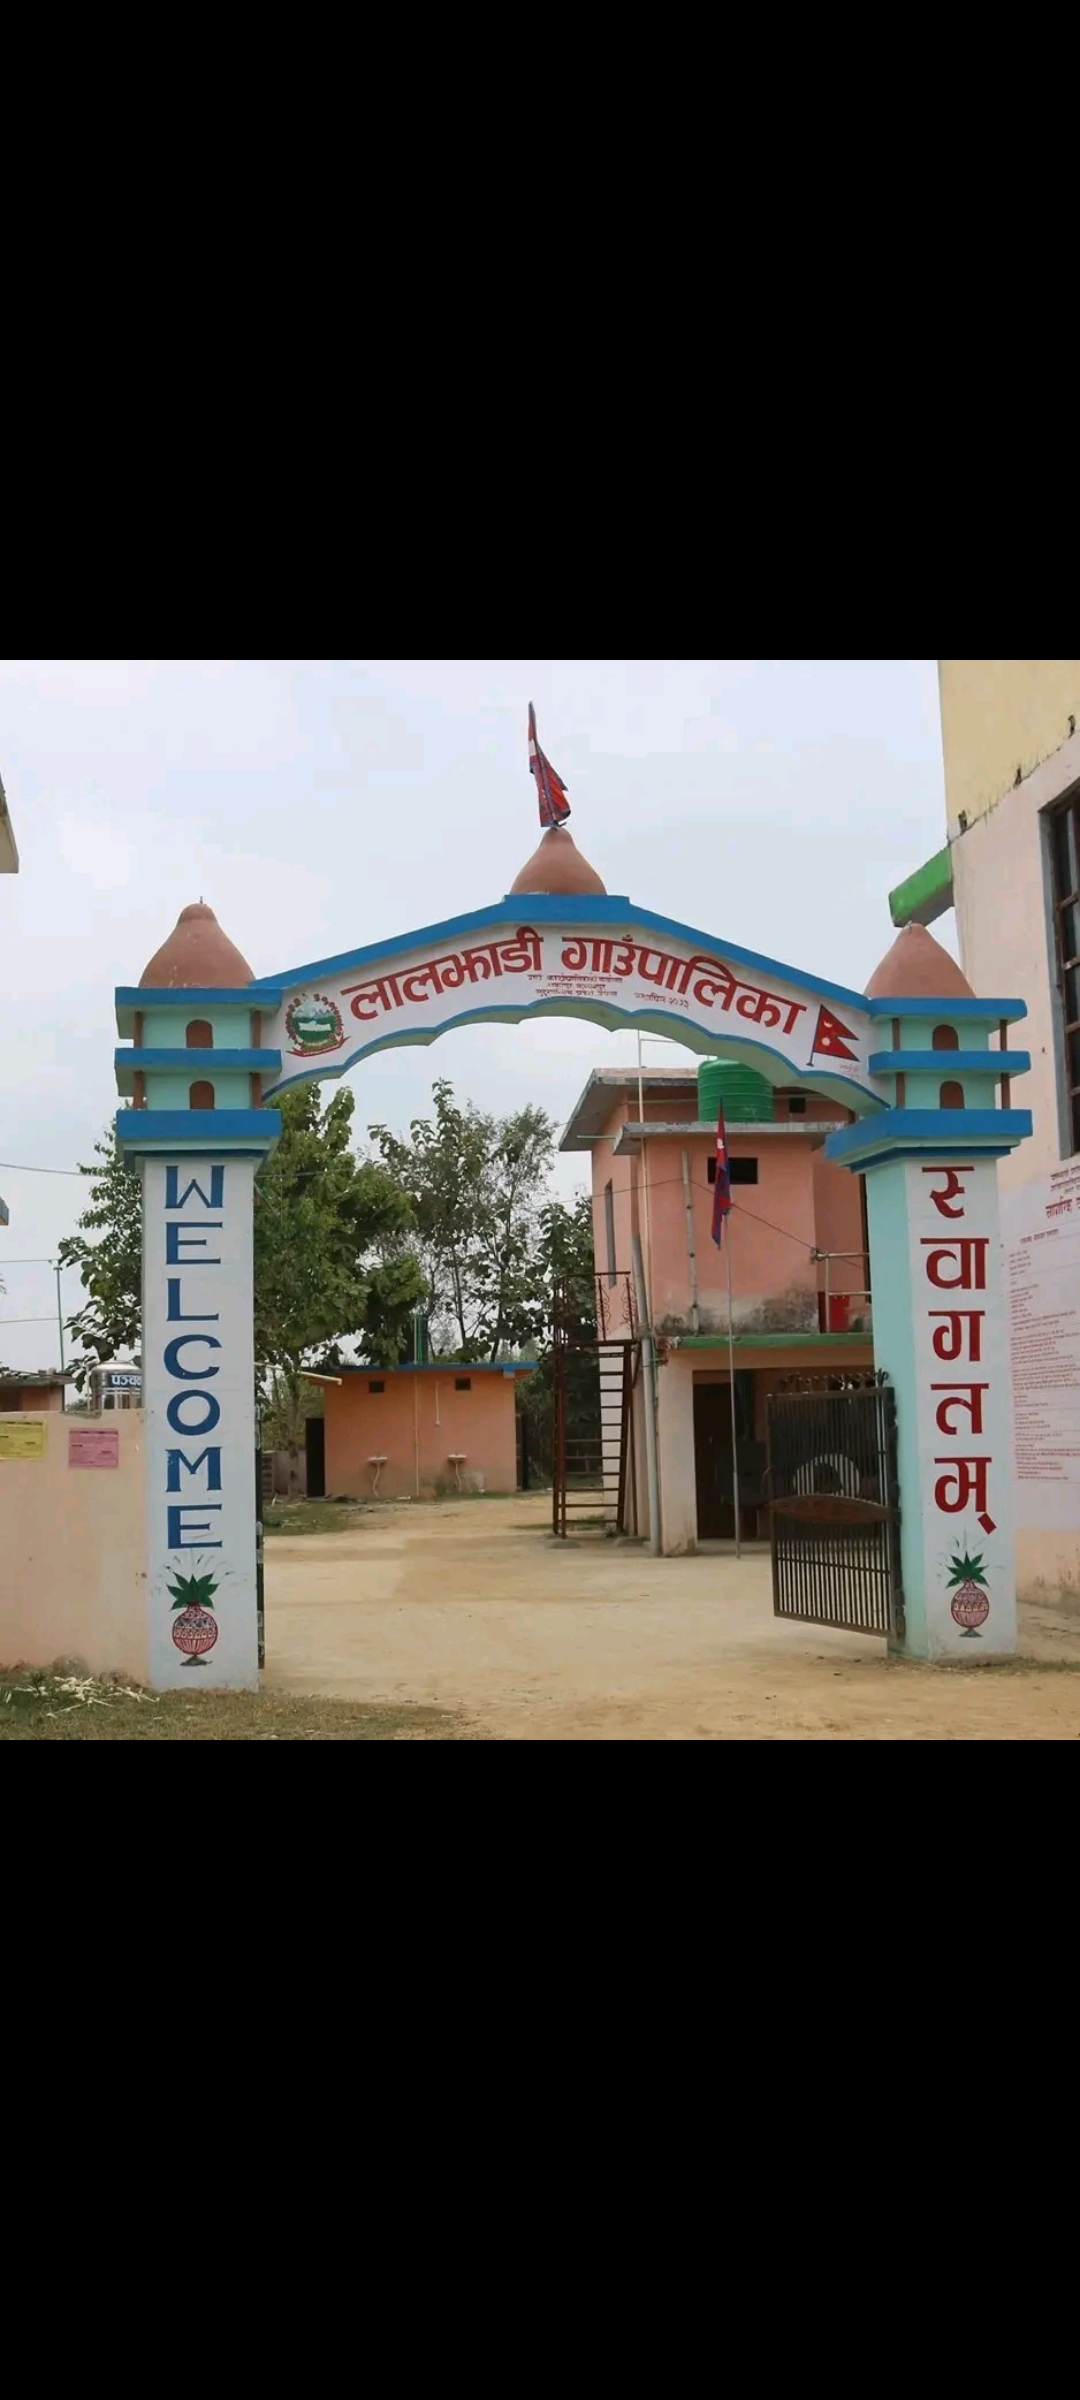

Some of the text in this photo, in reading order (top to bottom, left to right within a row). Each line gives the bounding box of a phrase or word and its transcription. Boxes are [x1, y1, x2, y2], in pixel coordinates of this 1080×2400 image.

[341, 926, 808, 1034] लालझाडी गाउँपालिका
[163, 1165, 224, 1549] WELCOME
[920, 1166, 996, 1534] स्वागतम्
